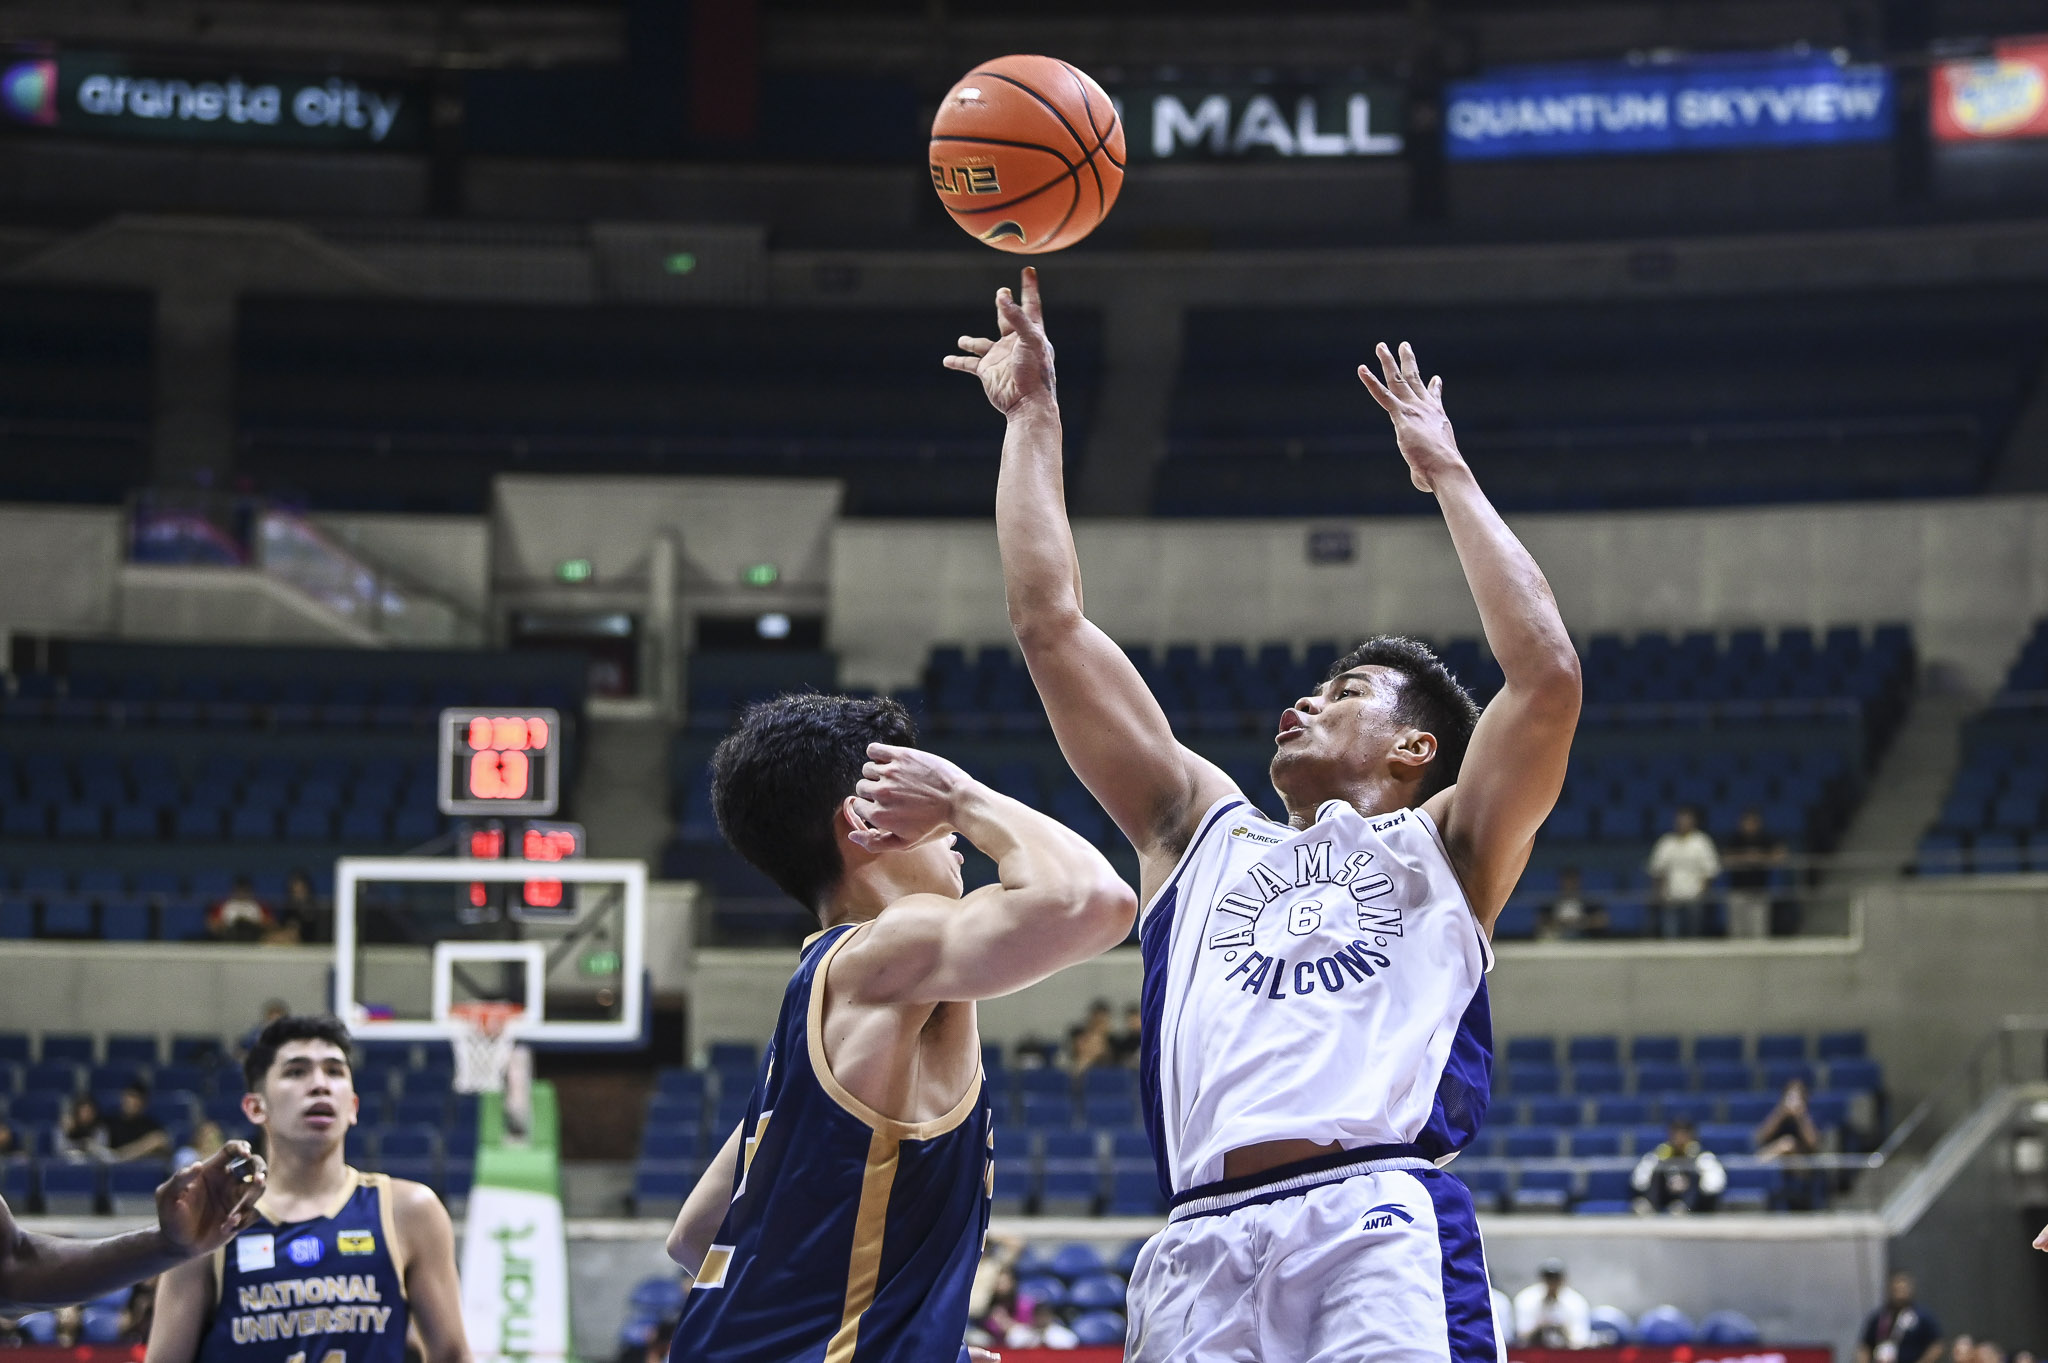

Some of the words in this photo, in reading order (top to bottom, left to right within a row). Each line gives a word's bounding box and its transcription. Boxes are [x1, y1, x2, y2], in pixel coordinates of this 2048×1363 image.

[77, 72, 282, 125] araneta
[292, 79, 404, 142] city
[1151, 93, 1404, 157] MALL
[1448, 93, 1667, 142] QUANTUM
[1676, 82, 1884, 130] SKYVIEW
[1209, 840, 1404, 951] ADAMSON
[1288, 899, 1323, 937] 6
[1225, 939, 1392, 1001] FALCONS
[1362, 1214, 1392, 1231] ANTA
[238, 1274, 382, 1312] NATIONAL
[232, 1305, 392, 1344] UNIVERSITY
